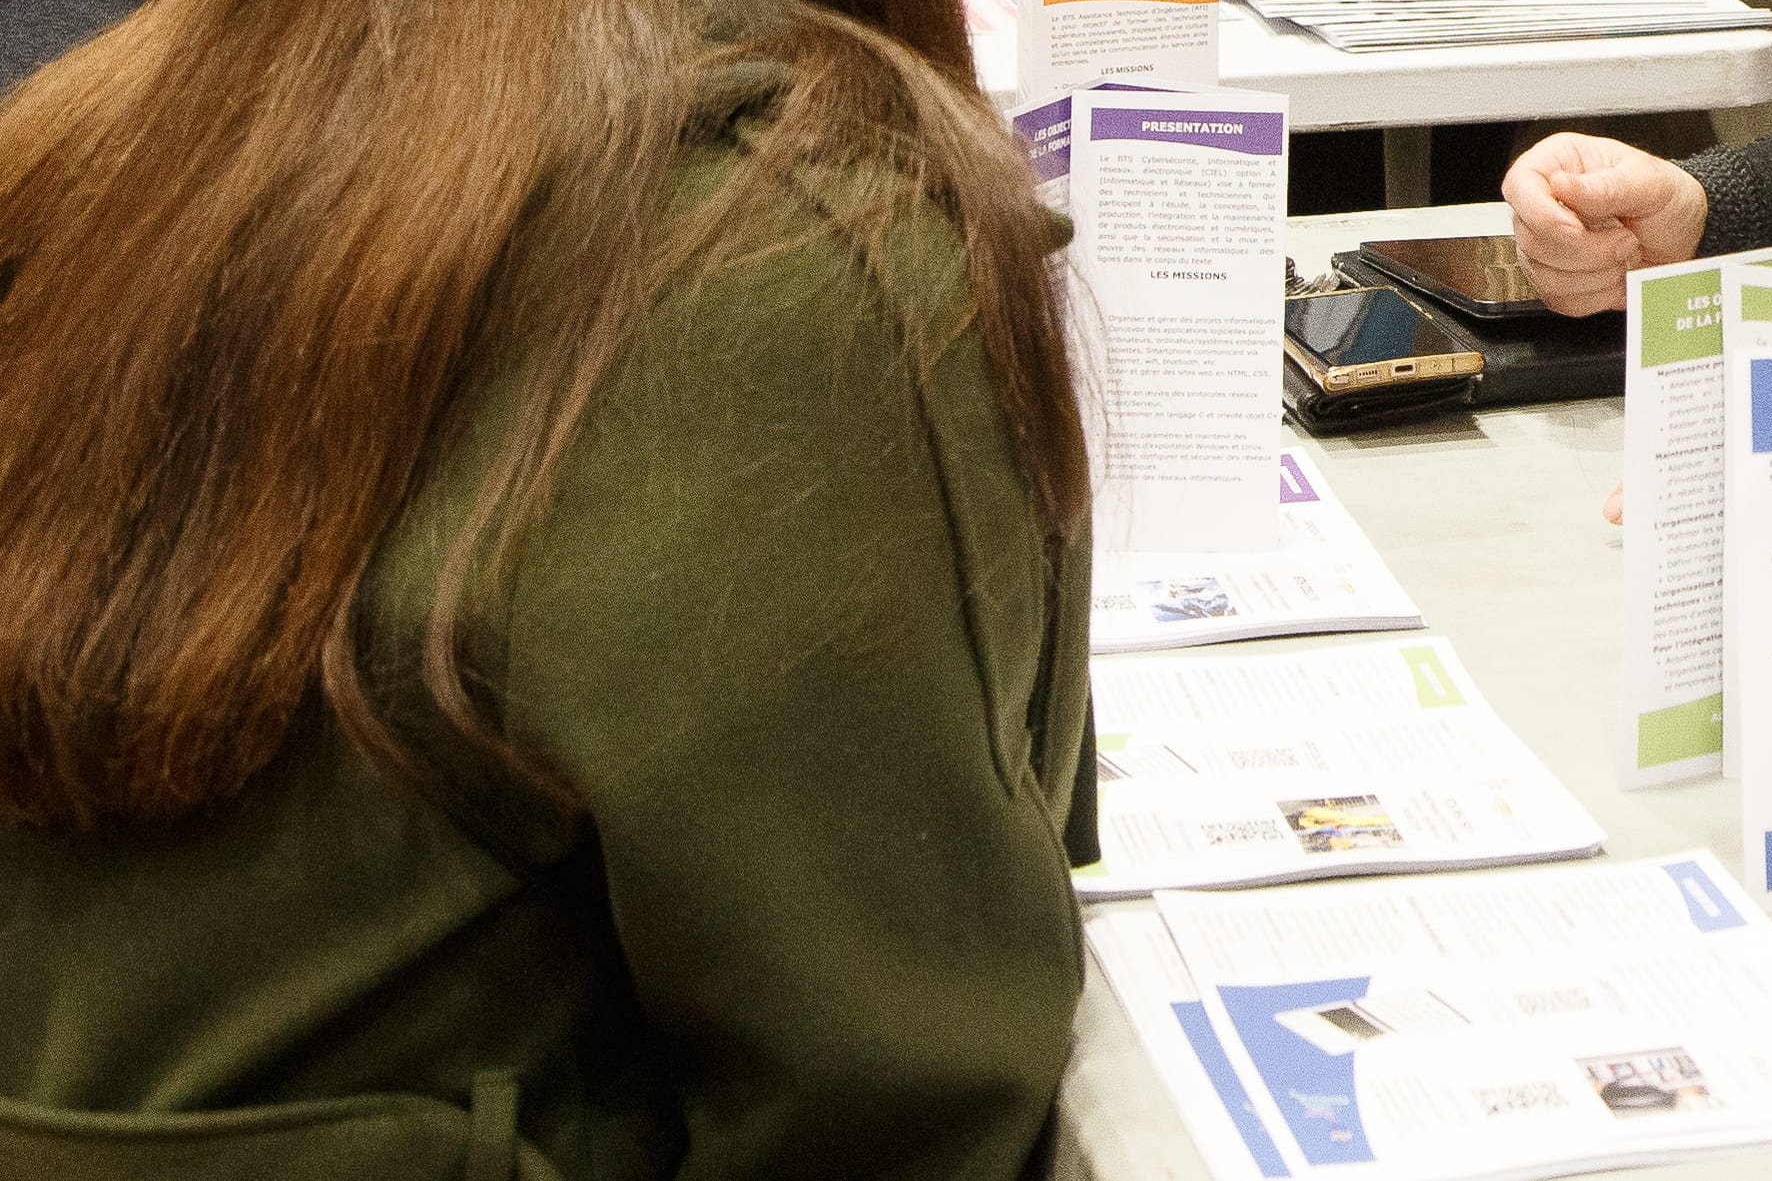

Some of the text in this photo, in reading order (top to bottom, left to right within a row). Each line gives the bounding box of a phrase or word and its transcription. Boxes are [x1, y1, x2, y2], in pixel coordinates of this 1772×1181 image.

[1116, 64, 1154, 76] MISSIONS
[1141, 120, 1244, 135] PRESENTATION
[1117, 155, 1133, 163] BTS
[1142, 156, 1199, 166] Cybersécurité,
[1208, 157, 1260, 167] Informatique
[1143, 168, 1192, 177] électronique
[1202, 169, 1227, 177] (CIEL)
[1236, 170, 1261, 178] option
[1099, 177, 1155, 187] (Informatique
[1174, 179, 1211, 188] Réseaux)
[1248, 181, 1275, 189] former
[1124, 189, 1168, 197] techniciens
[1198, 191, 1252, 199] techniciennes
[1099, 200, 1141, 209] participent
[1214, 203, 1260, 211] conception,
[1148, 212, 1195, 221] l'intégration
[1223, 214, 1274, 222] maintenance
[1114, 222, 1146, 231] produits
[1152, 223, 1205, 233] électroniques
[1224, 225, 1274, 234] numériques,
[1157, 235, 1205, 243] sécurisation
[1239, 236, 1258, 244] mise
[1193, 247, 1248, 256] informatiques
[1097, 255, 1120, 263] lignes
[1155, 257, 1176, 265] corps
[1151, 272, 1227, 282] LES MISSIONS
[1687, 295, 1709, 311] LES
[1676, 314, 1713, 332] DE LA
[1657, 363, 1710, 378] Maintenance
[1655, 446, 1709, 461] Maintenance
